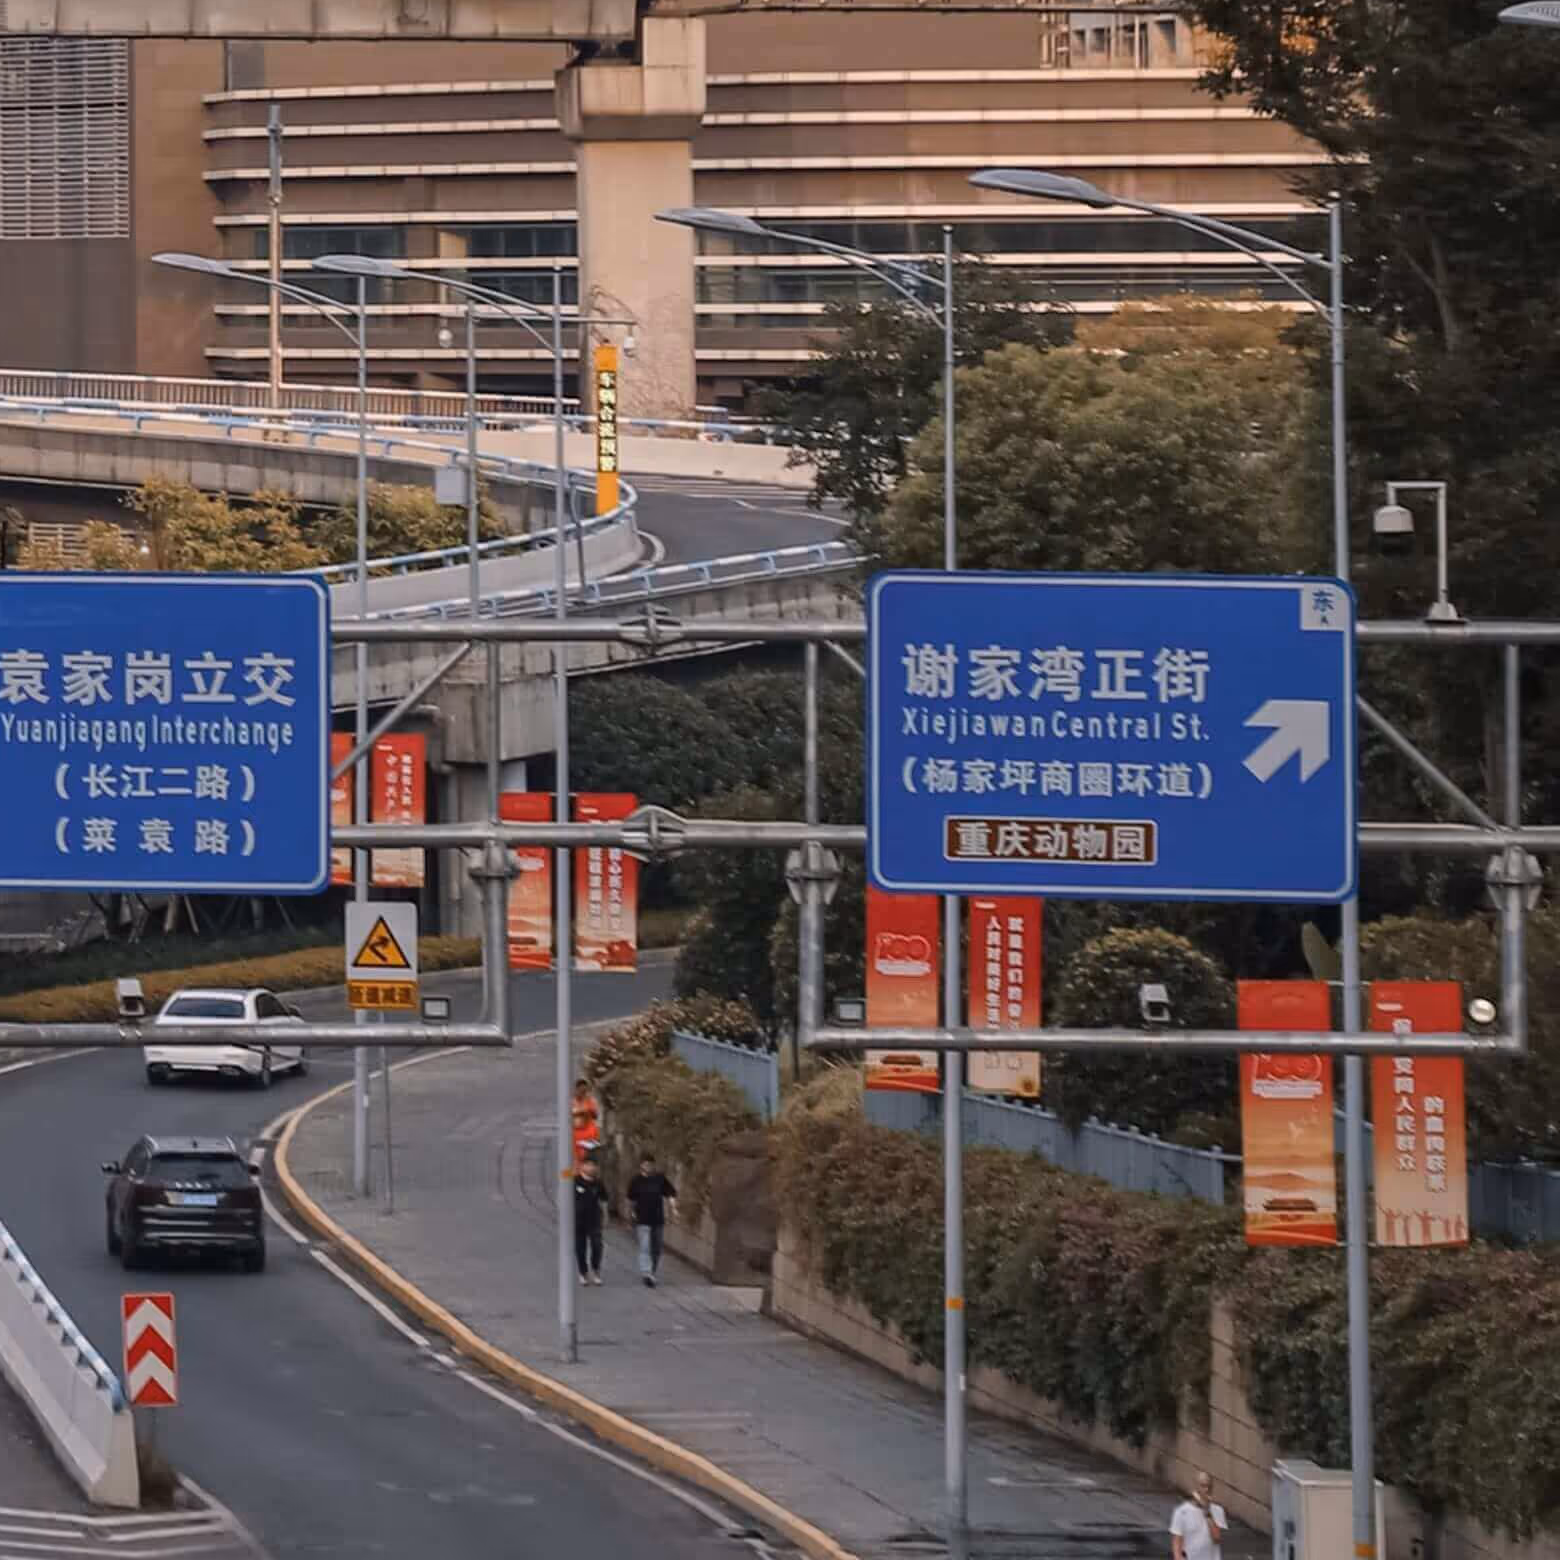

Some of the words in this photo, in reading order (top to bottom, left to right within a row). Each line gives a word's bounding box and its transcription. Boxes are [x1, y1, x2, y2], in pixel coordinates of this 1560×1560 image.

[901, 643, 1211, 704] 谢家湾正街
[0, 712, 146, 752] Yuanjiagang
[152, 714, 294, 754] Interchange
[901, 707, 1043, 744] Xiejiawan
[1051, 711, 1162, 740] Central
[1170, 712, 1211, 741] St.
[54, 763, 256, 802] (长江二路)
[901, 755, 1213, 798] (杨家坪商圈环道)
[954, 821, 1148, 861] 重庆动物园
